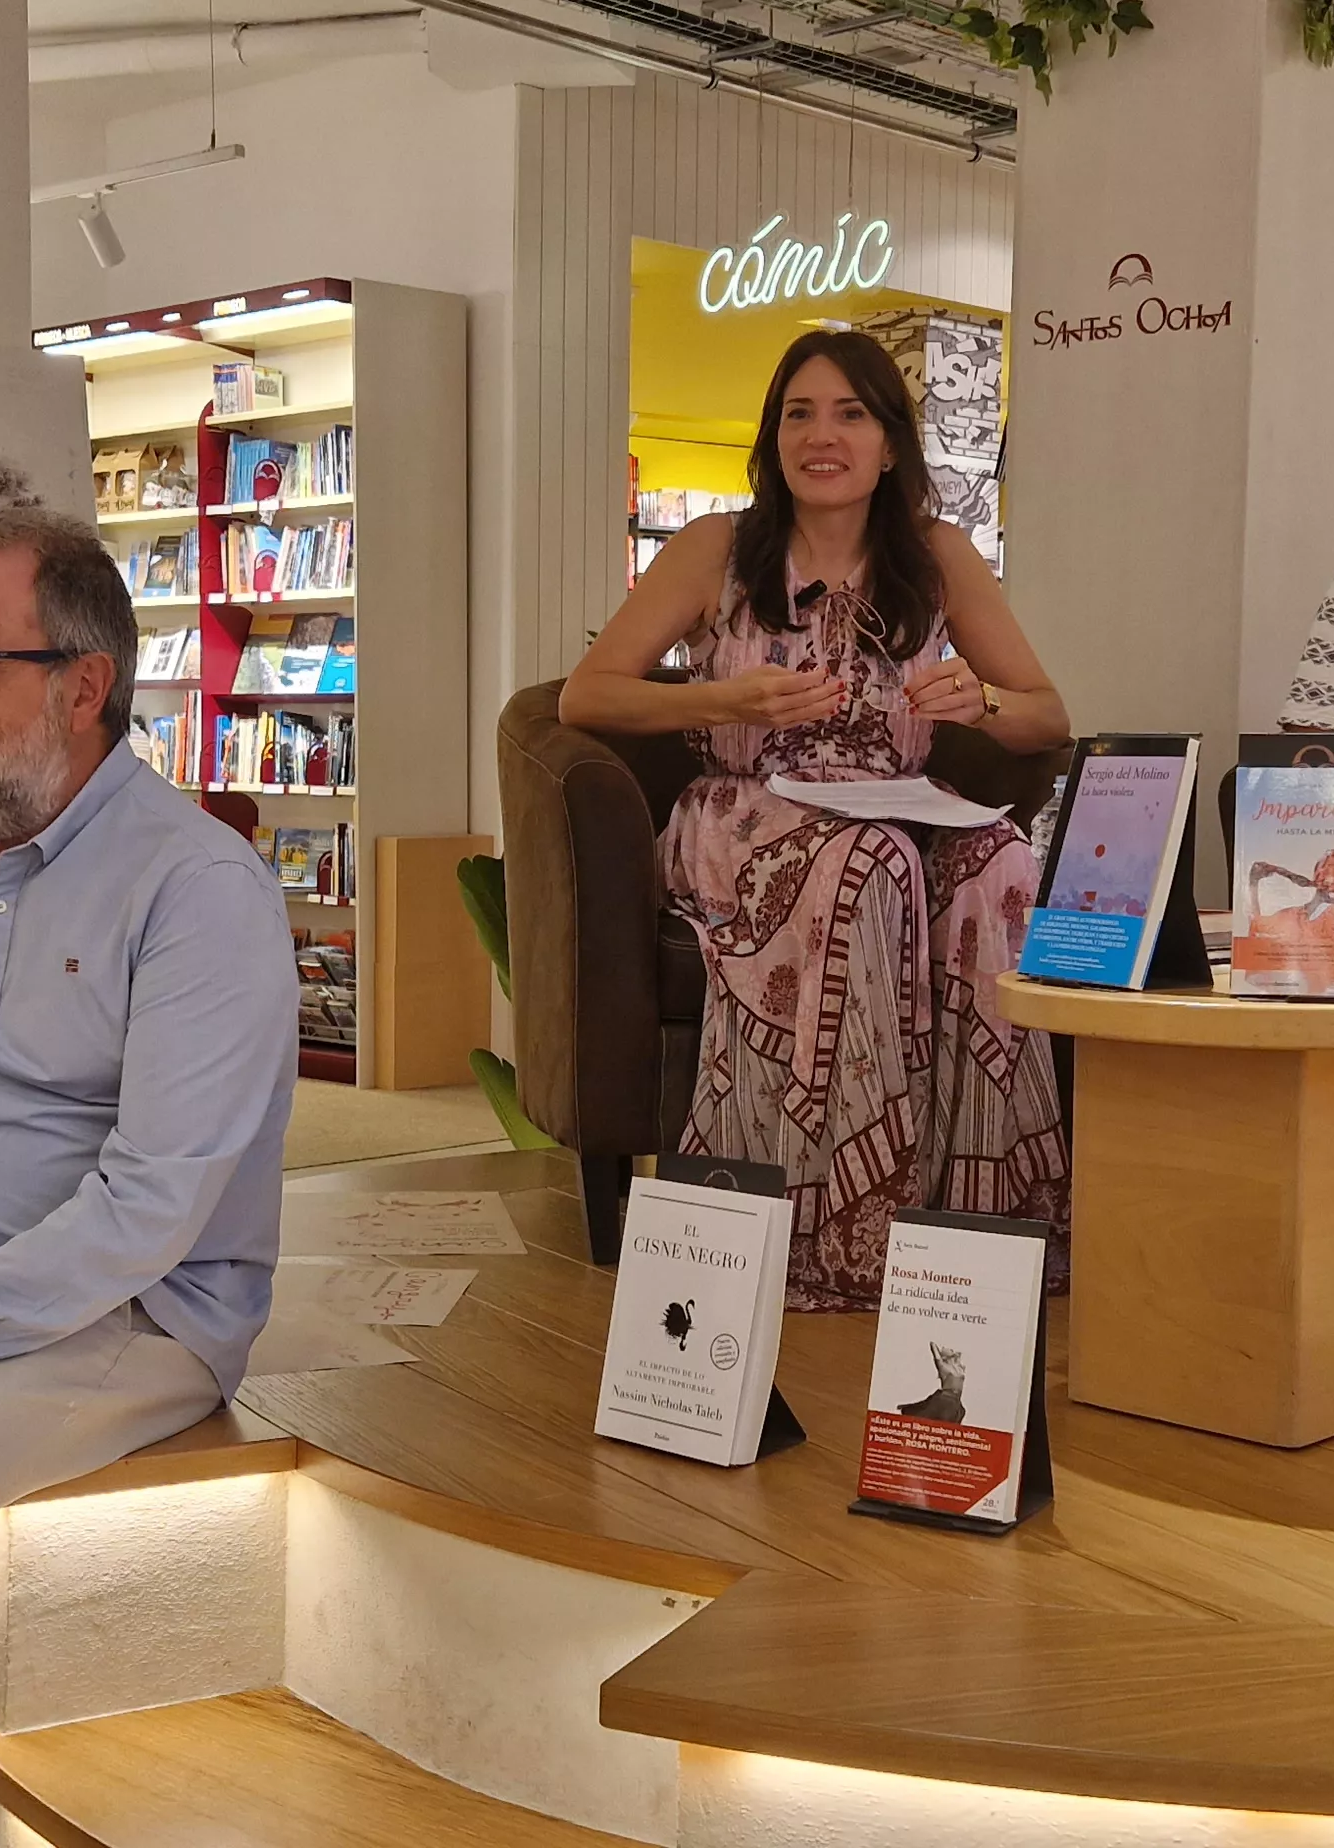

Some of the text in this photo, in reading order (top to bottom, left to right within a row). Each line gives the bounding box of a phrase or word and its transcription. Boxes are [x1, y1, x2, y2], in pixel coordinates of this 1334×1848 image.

[1085, 767, 1170, 783] Sergio del Molino
[1081, 786, 1134, 796] La hora violeta
[1276, 828, 1307, 836] HASTA
[684, 1224, 699, 1238] EL
[633, 1236, 747, 1271] CISNE NEGRO
[891, 1265, 972, 1286] Rosa Montero
[890, 1284, 969, 1304] La ridícula idea
[887, 1301, 987, 1325] de no volver a verte
[649, 1361, 680, 1375] IMPACTO
[682, 1369, 692, 1377] DE
[694, 1371, 705, 1380] LO
[625, 1369, 715, 1395] ALTAMENTE IMPROBABLE
[612, 1384, 723, 1421] Nassim Nicholas Taleb
[902, 1421, 912, 1429] un
[913, 1421, 930, 1432] libro
[931, 1425, 953, 1435] sobre
[954, 1428, 962, 1437] la
[905, 1439, 928, 1450] ROSA
[928, 1444, 971, 1457] MONTERO.
[912, 1431, 917, 1439] y
[919, 1433, 944, 1445] alegre,
[946, 1437, 991, 1451] sentimental
